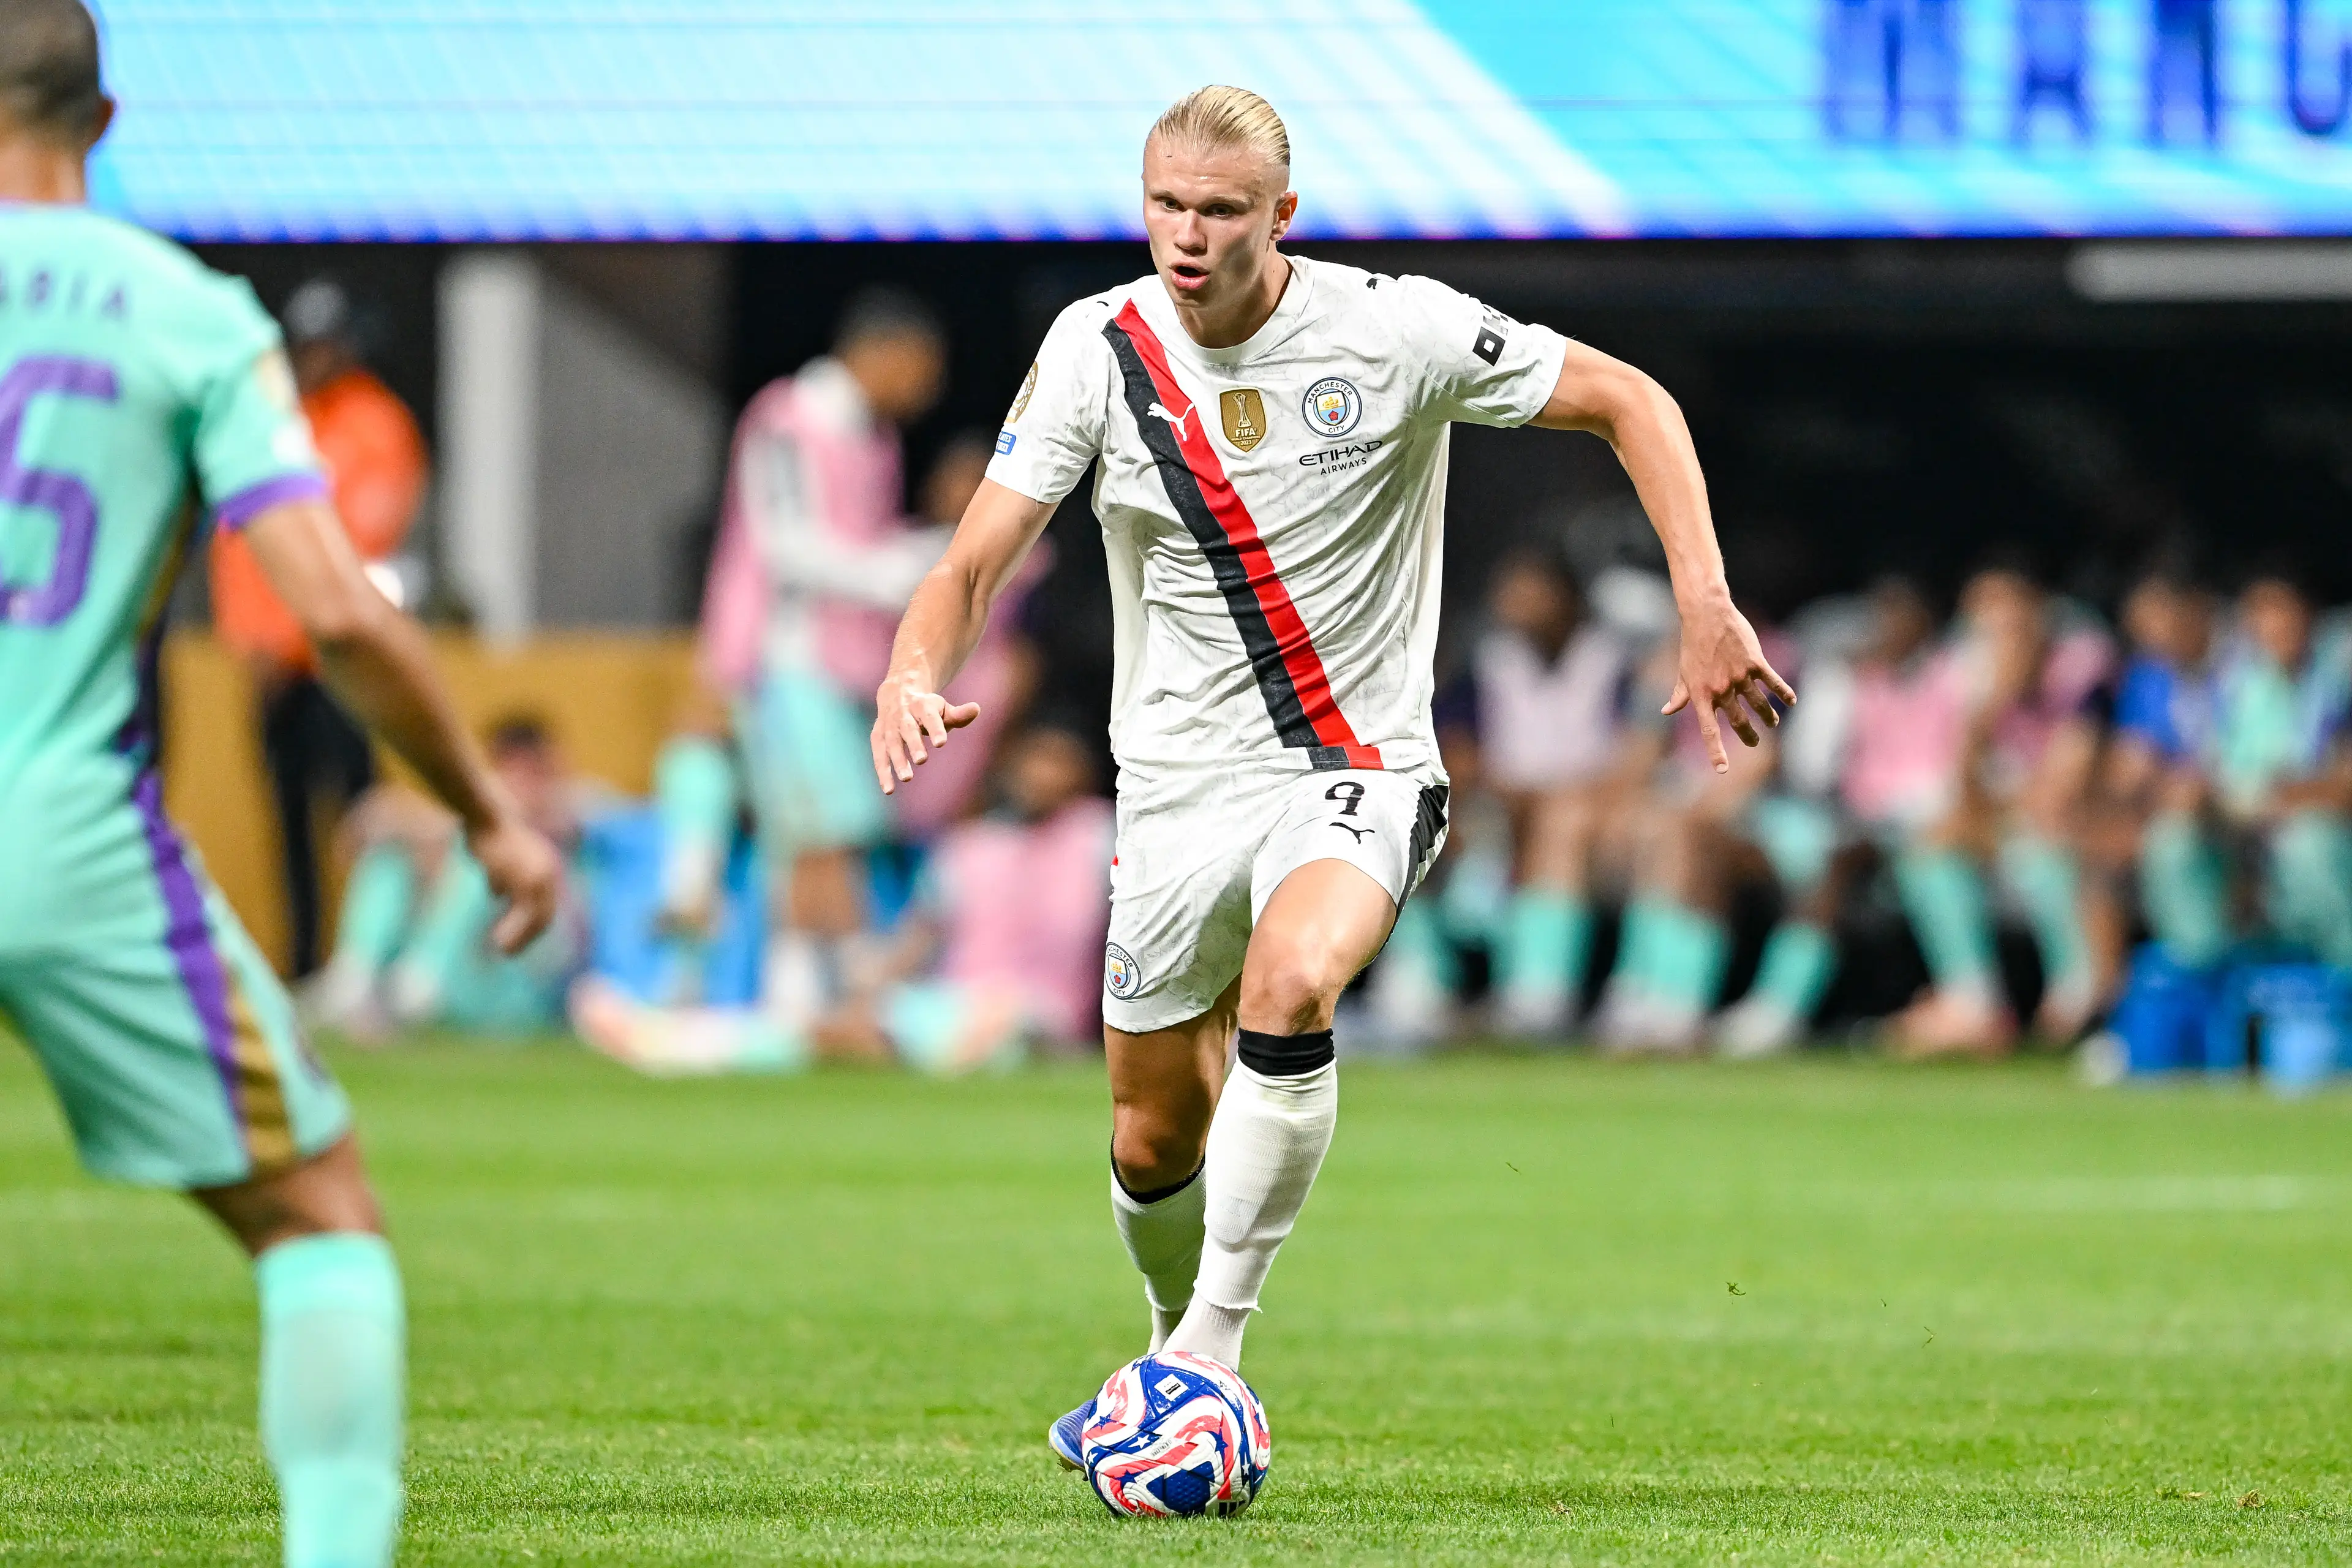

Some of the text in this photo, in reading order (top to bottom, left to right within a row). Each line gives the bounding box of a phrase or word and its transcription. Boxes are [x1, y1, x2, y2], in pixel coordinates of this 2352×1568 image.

[1308, 382, 1352, 404] MANCHESTER
[1235, 428, 1256, 437] FIFA
[1299, 440, 1382, 466] ETIHAD
[1321, 457, 1367, 475] AIRWAYS
[0, 352, 119, 628] 5
[1325, 782, 1365, 816] 9
